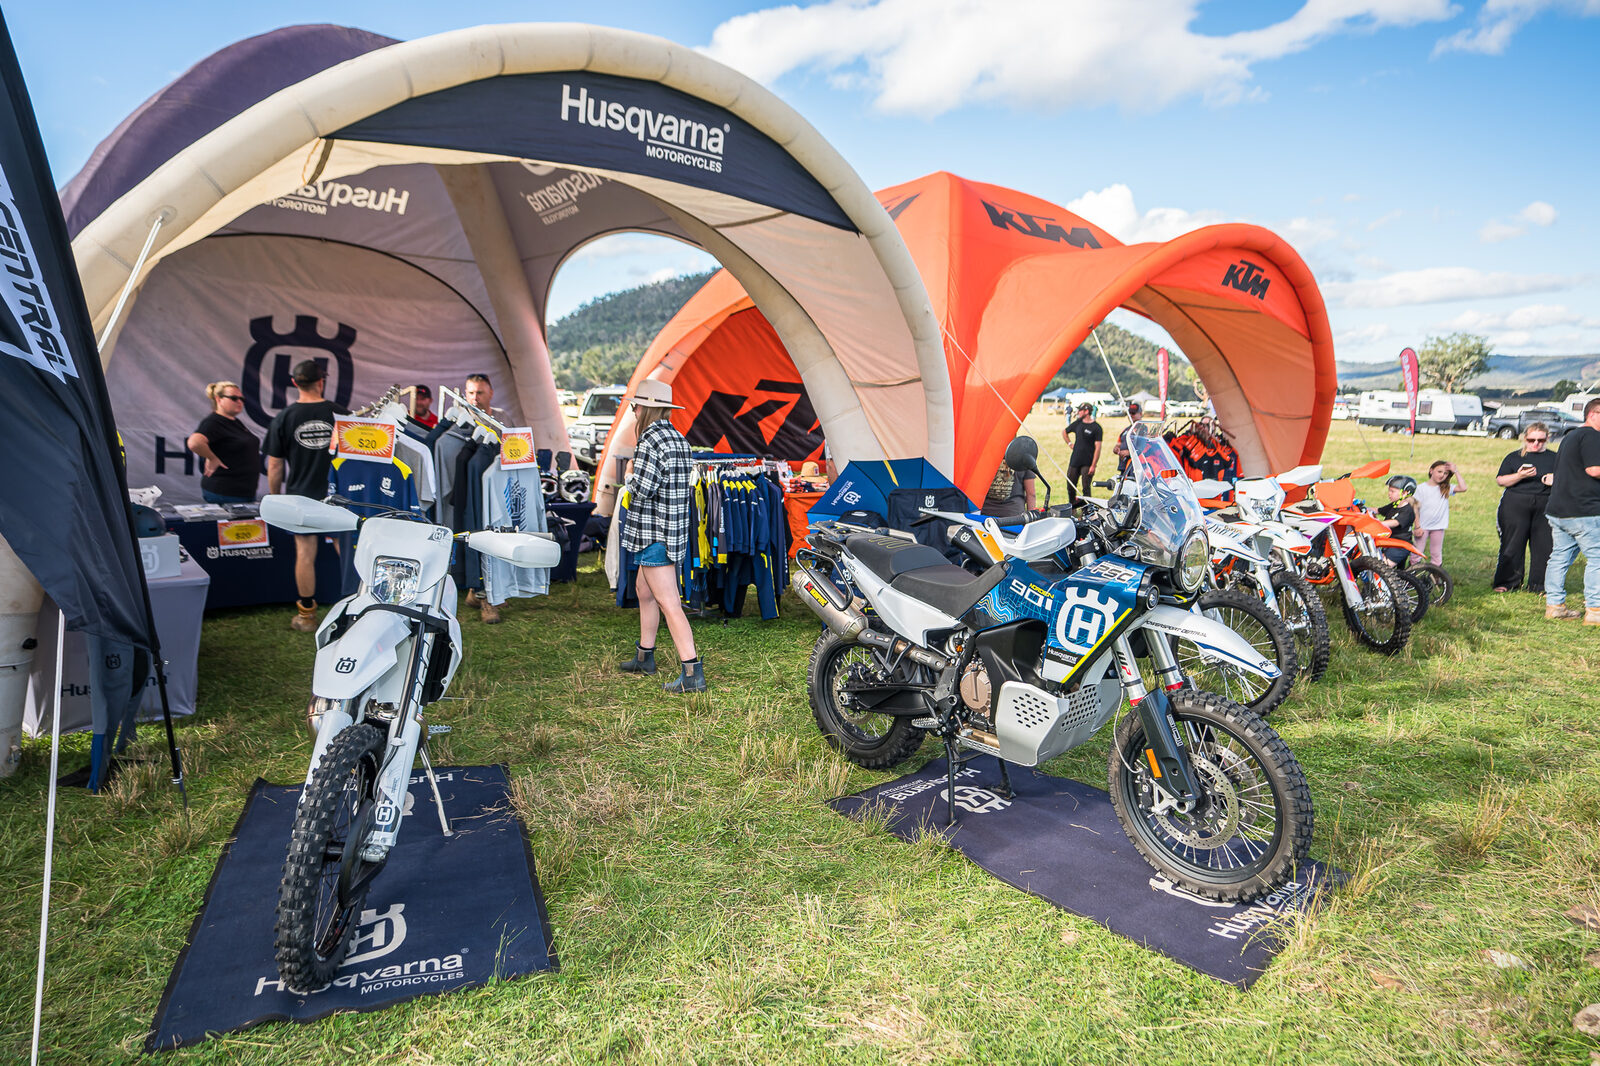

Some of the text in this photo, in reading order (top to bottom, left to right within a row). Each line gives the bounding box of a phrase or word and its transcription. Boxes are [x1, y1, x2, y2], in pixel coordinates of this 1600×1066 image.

[561, 84, 724, 155] Husqvarna
[646, 145, 722, 173] MOTORCYCLES
[981, 199, 1103, 249] KTM
[1221, 259, 1270, 300] KTM
[358, 438, 377, 449] $20
[254, 953, 463, 997] Hqvarna
[361, 971, 464, 995] MOTORCYCLES
